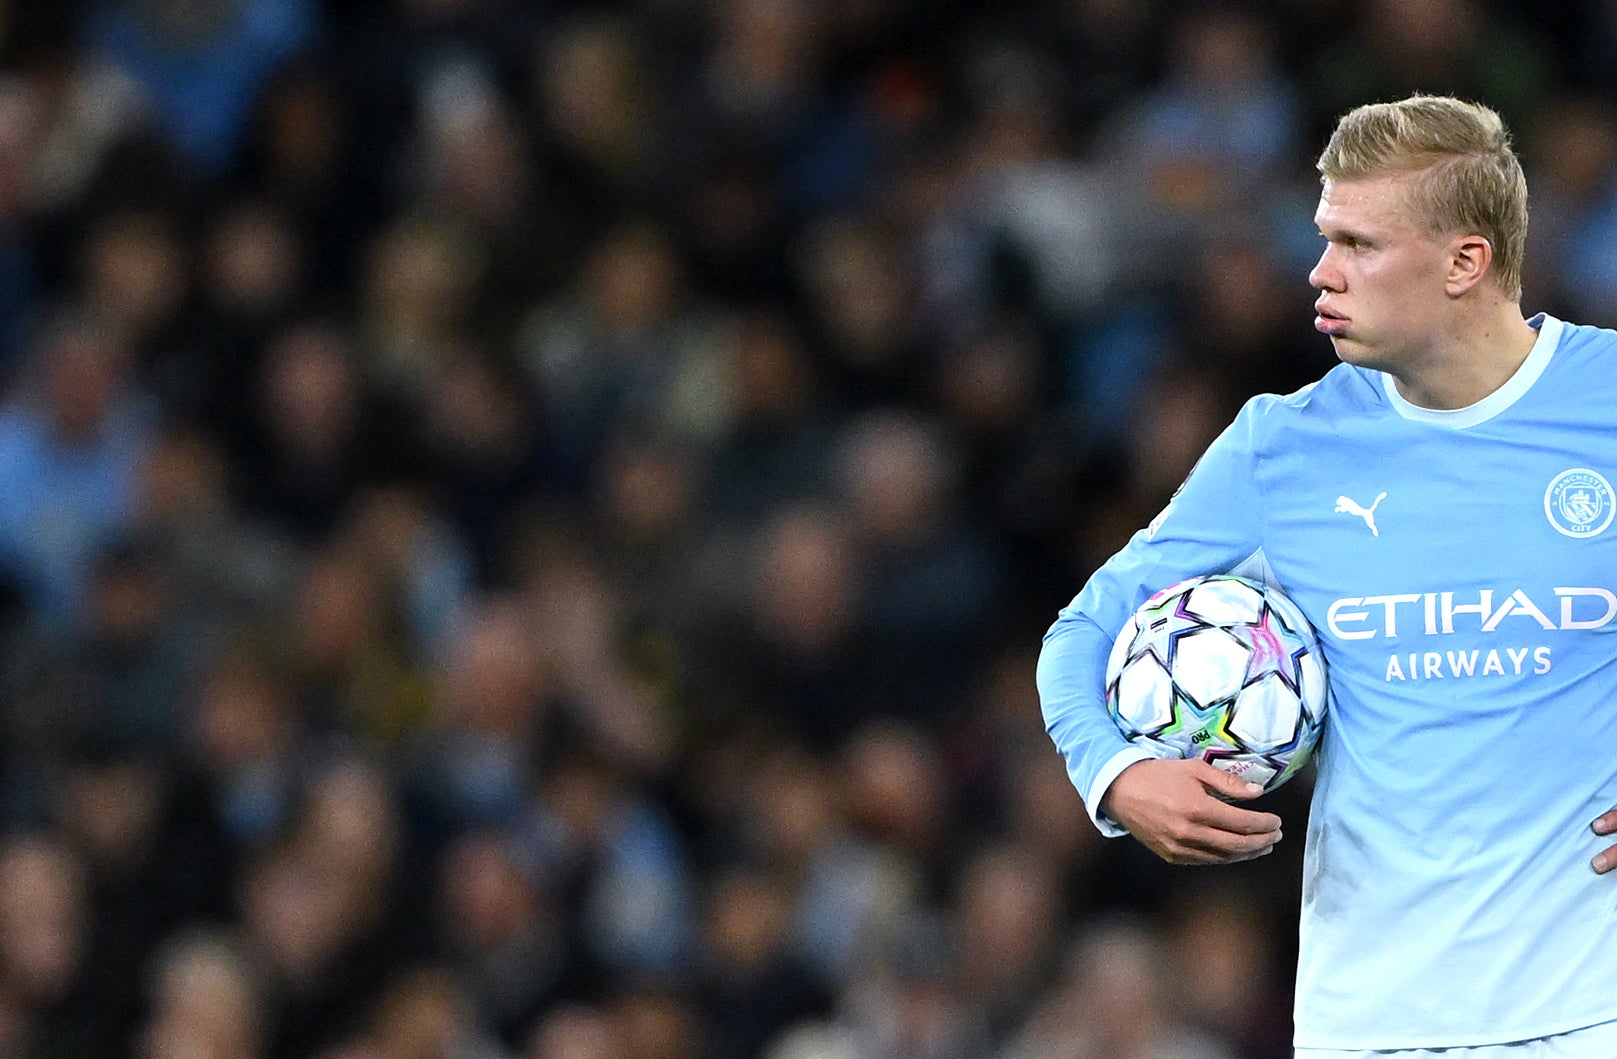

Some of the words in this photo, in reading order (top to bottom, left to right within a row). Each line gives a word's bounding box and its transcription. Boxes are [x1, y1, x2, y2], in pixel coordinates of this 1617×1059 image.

[1553, 475, 1607, 496] MANCHESTER
[1571, 524, 1592, 532] CITY
[1327, 586, 1617, 640] ETIHAD
[1385, 647, 1552, 682] AIRWAYS
[1191, 729, 1211, 744] PRO
